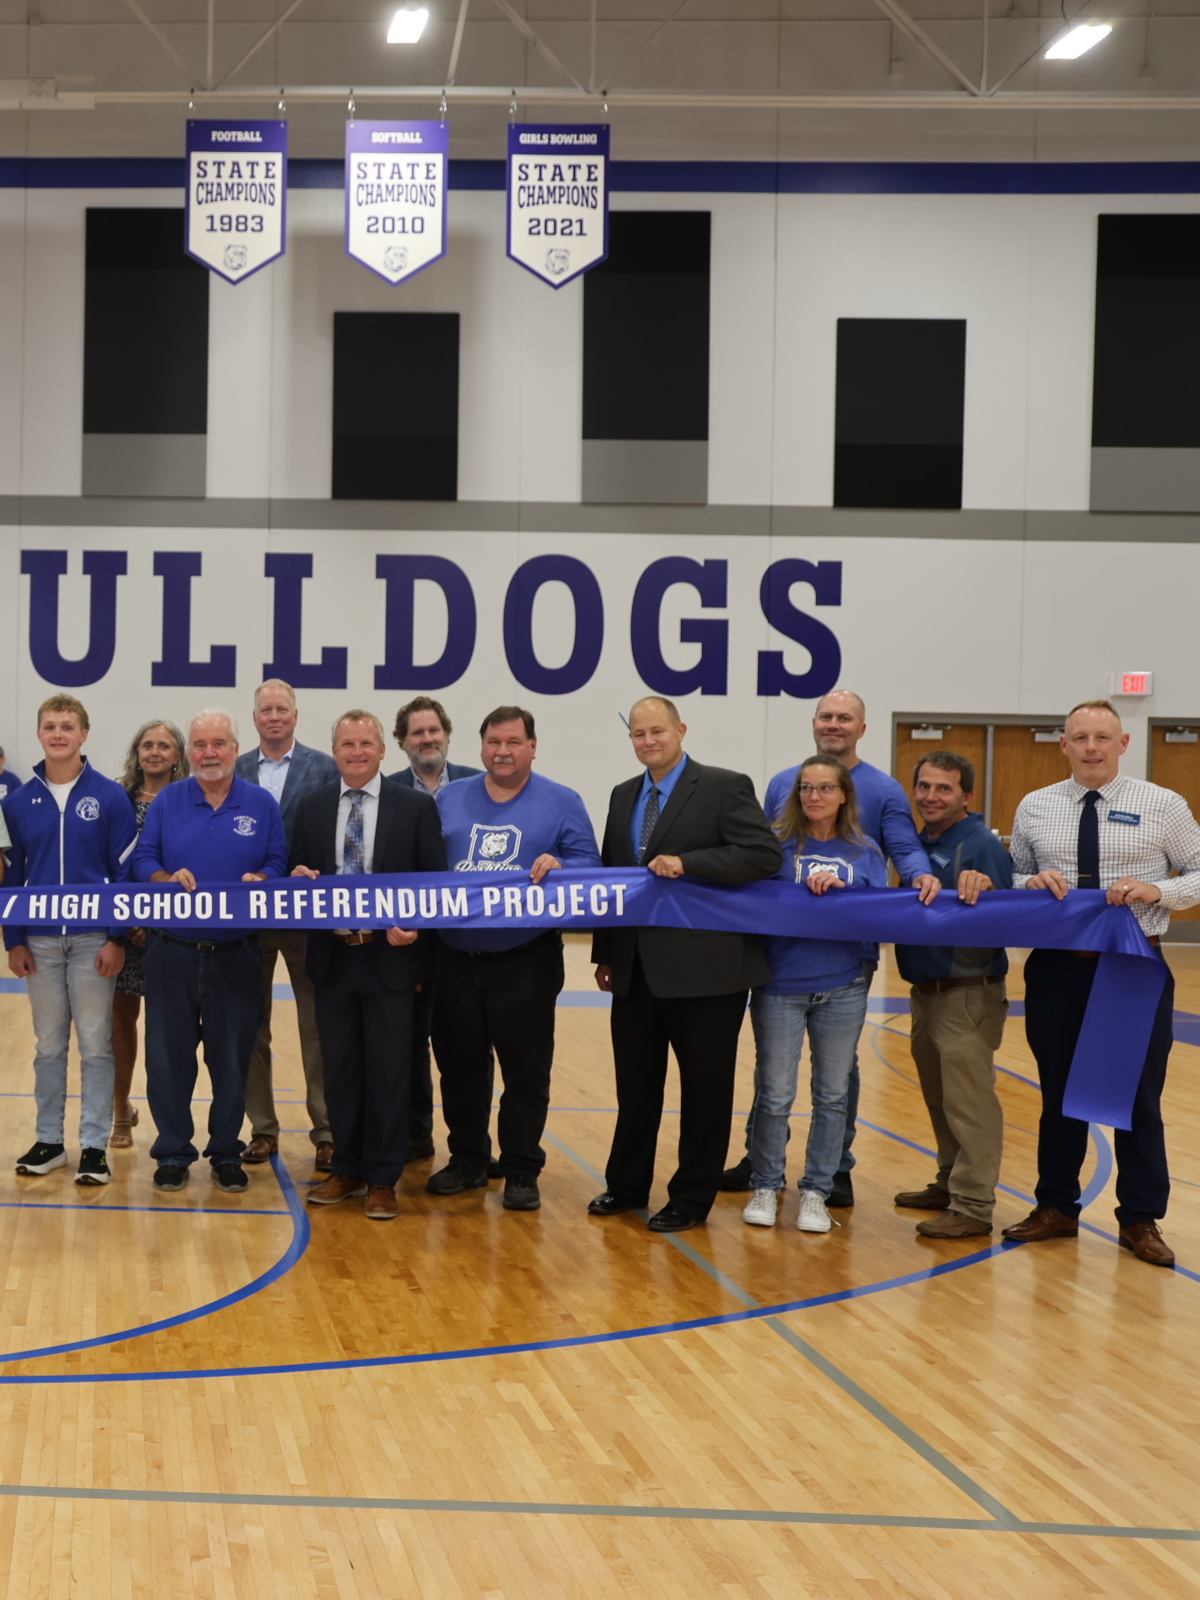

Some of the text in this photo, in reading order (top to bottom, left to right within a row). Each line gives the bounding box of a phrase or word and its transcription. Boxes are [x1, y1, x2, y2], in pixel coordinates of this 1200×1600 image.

[211, 131, 263, 143] FOOTBALL
[371, 132, 423, 144] SOFTBALL
[519, 133, 598, 146] GIRLS BOWLING
[196, 160, 276, 179] STATE
[357, 163, 436, 180] STATE
[518, 163, 598, 182] STATE
[196, 183, 276, 206] CHAMPIONS
[357, 183, 436, 208] CHAMPIONS
[518, 185, 598, 209] CHAMPIONS
[205, 214, 264, 233] 1983
[366, 216, 425, 234] 2010
[528, 218, 587, 236] 2021
[1122, 674, 1147, 693] EXIT
[1, 894, 19, 919] /
[29, 893, 100, 920] HIGH
[113, 891, 234, 921] SCHOOL
[249, 886, 469, 920] REFERENDUM
[483, 883, 627, 918] PROJECT
